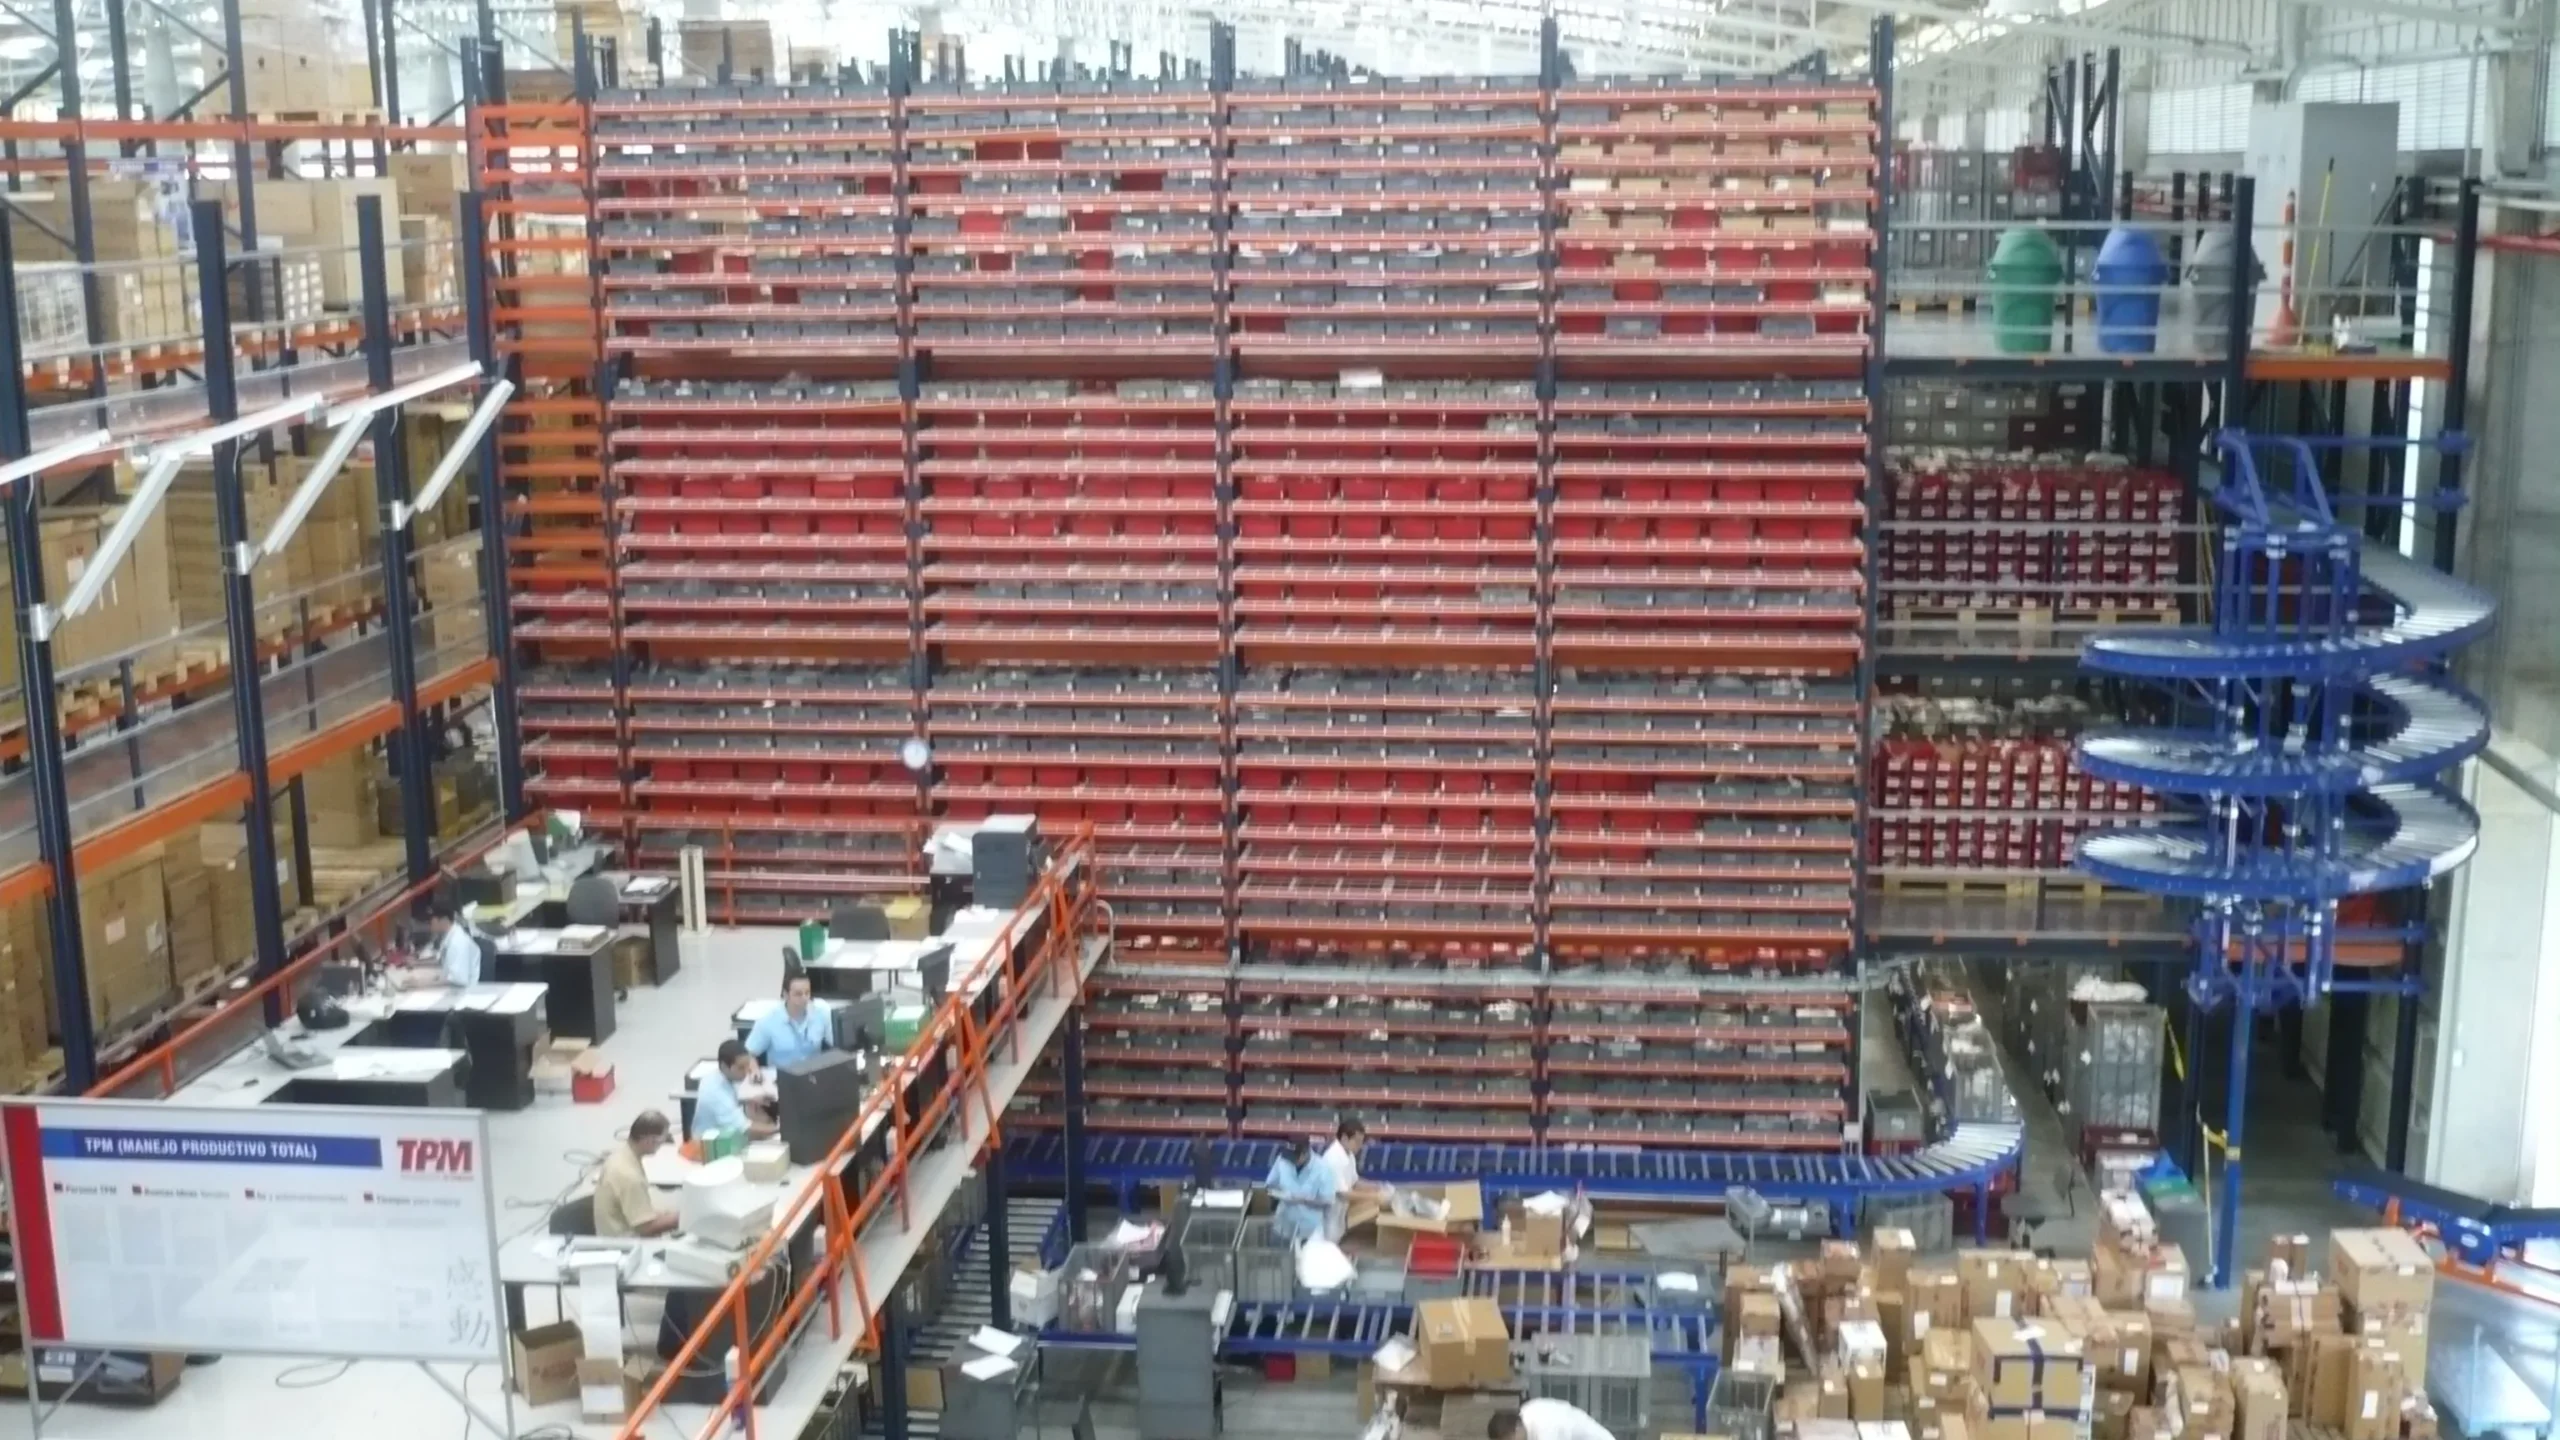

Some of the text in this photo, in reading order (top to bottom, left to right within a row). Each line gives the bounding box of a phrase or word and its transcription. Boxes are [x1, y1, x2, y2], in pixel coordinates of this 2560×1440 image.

[84, 1137, 317, 1161] TPM (MANEJO PRODUCTIVO TOTAL)
[397, 1138, 473, 1172] TPM
